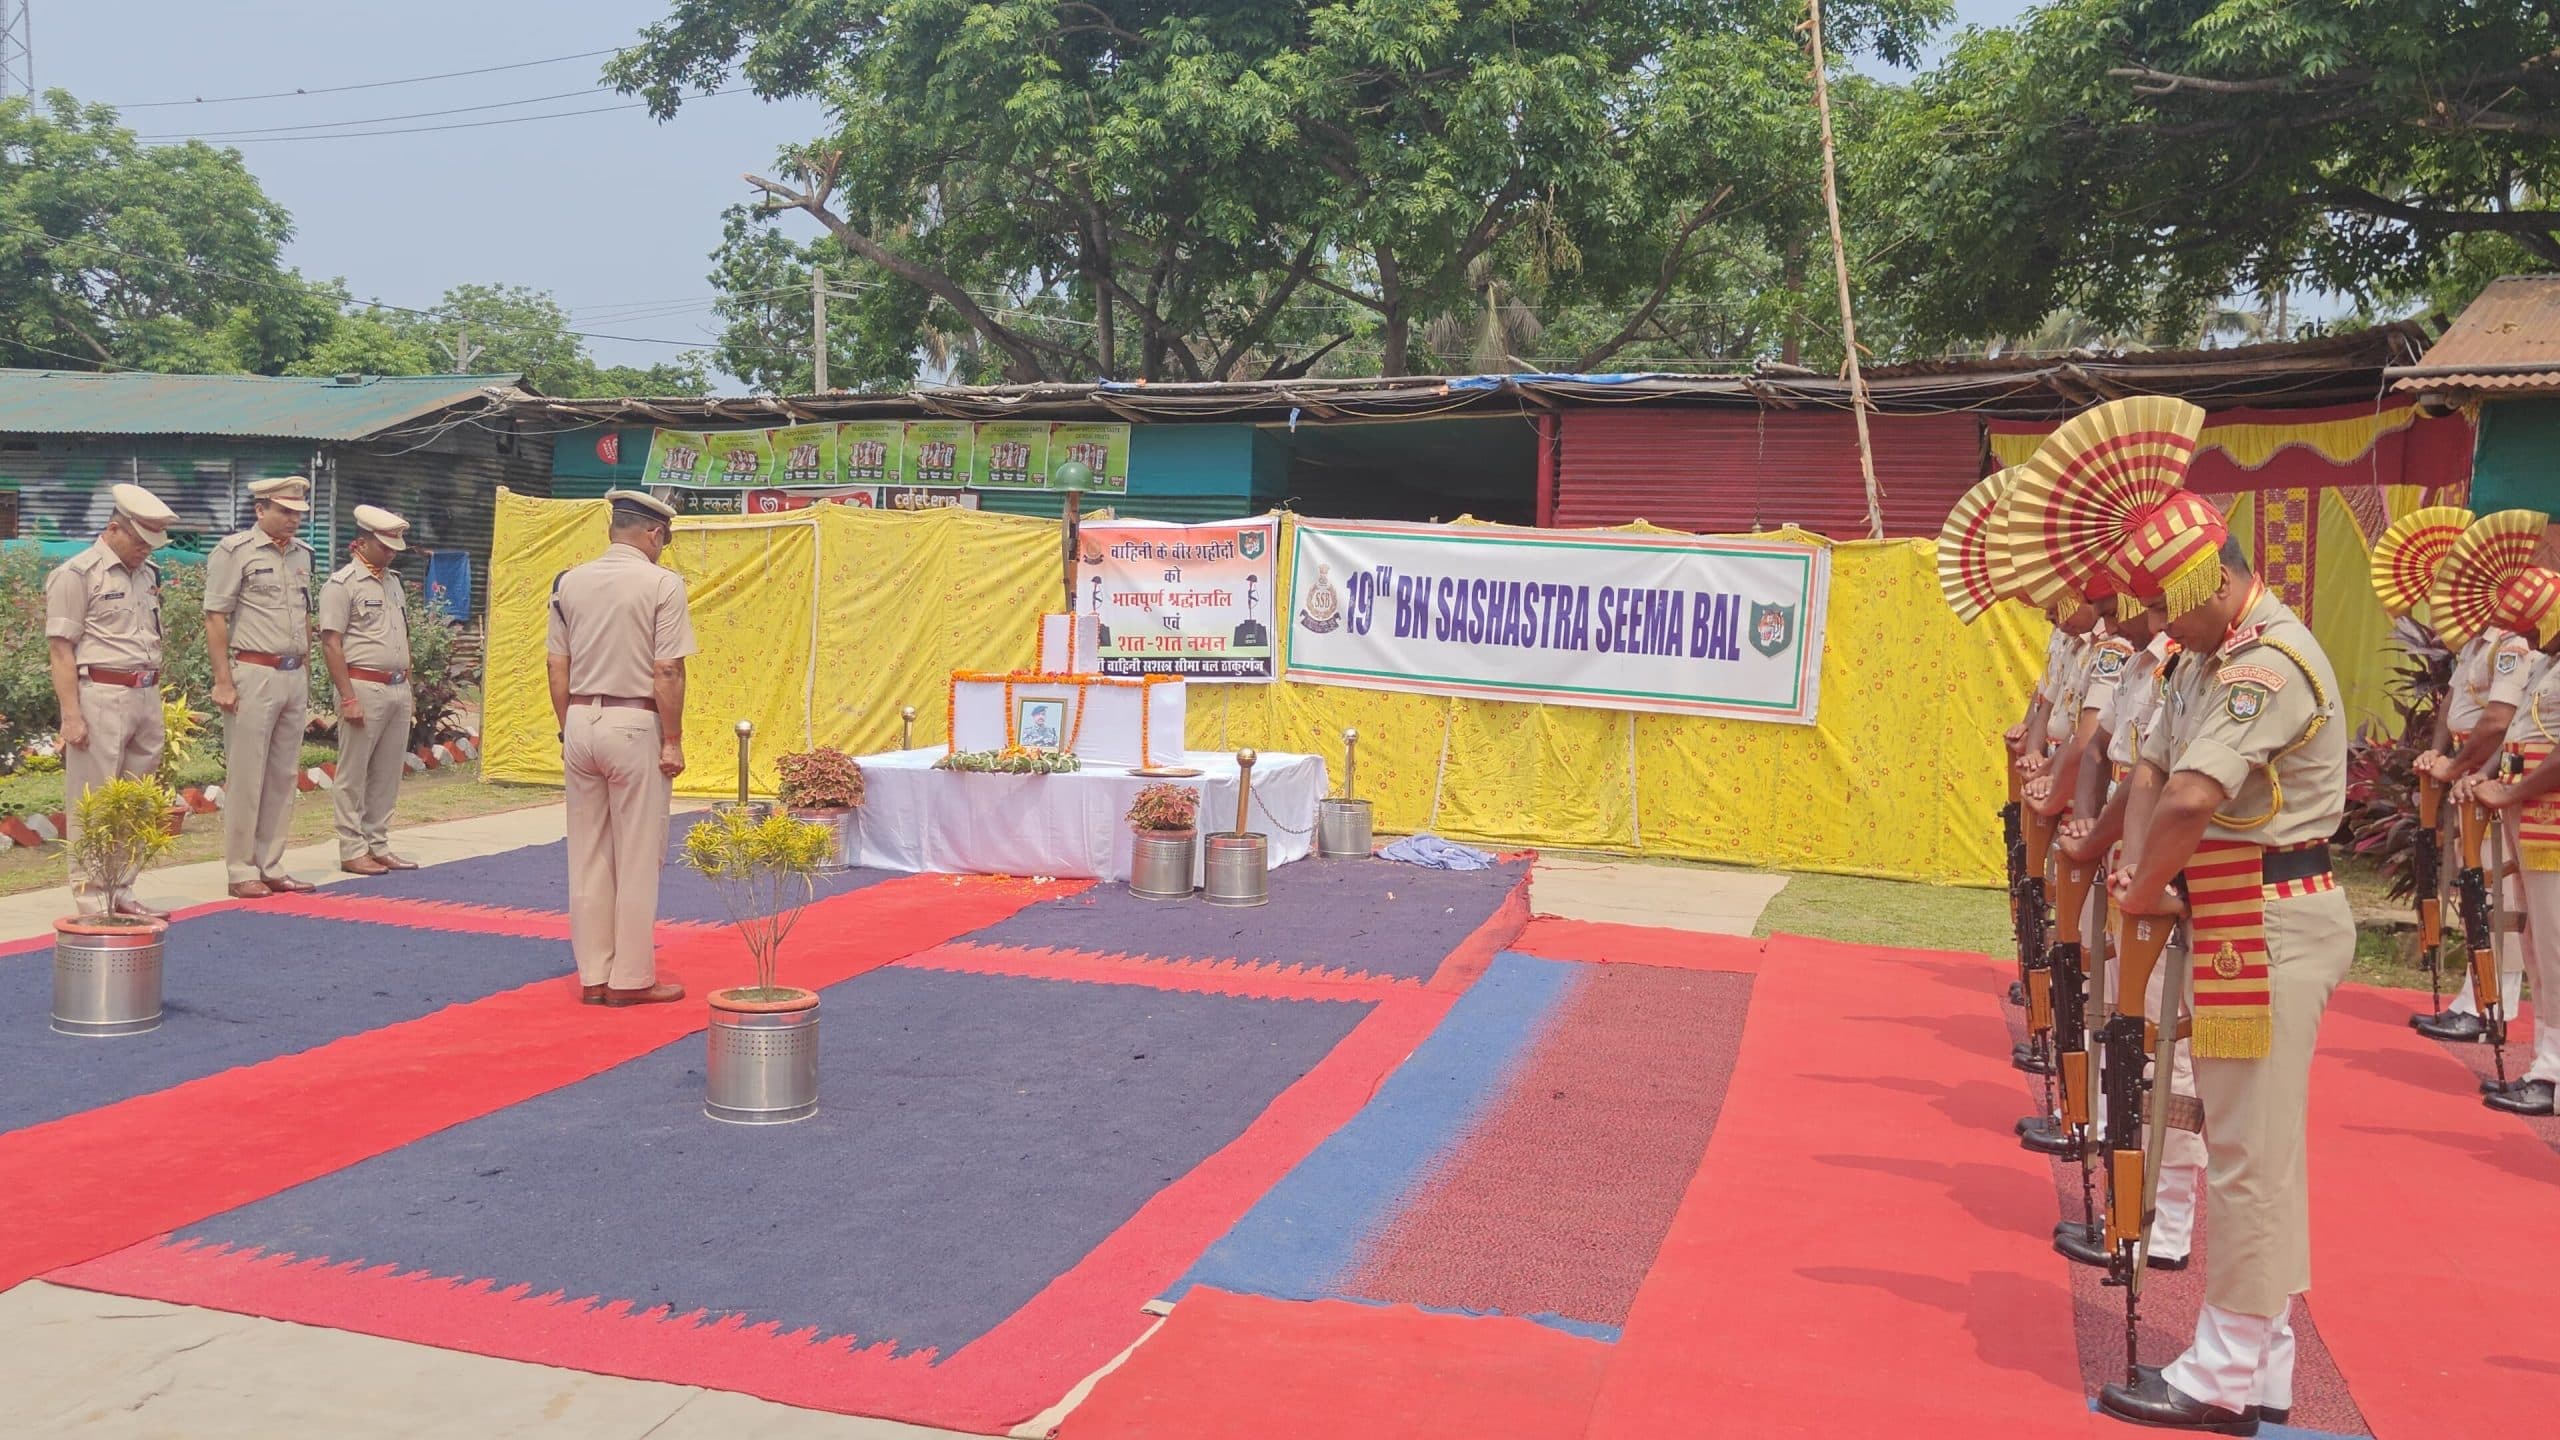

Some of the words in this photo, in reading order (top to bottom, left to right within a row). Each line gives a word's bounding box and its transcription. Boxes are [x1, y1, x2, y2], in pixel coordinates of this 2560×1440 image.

[894, 488, 957, 511] cafeteria
[1111, 541, 1152, 562] वाहिनी
[1156, 541, 1168, 560] के
[1172, 542, 1191, 560] वीर
[1196, 540, 1234, 561] शहीदों
[1164, 566, 1181, 583] को
[1113, 589, 1165, 612] भावपूर्ण
[1168, 589, 1232, 608] श्रद्धांजलि
[1314, 592, 1330, 608] SSB
[1163, 613, 1181, 630] एवं
[1394, 574, 1432, 640] BN
[1435, 577, 1589, 652] SASHASTRA
[1595, 586, 1683, 658] SEEMA
[1690, 591, 1741, 662] BAL
[1187, 636, 1227, 651] नमन
[1107, 658, 1141, 674] वाहिनी
[1142, 659, 1172, 673] सशस्त्र
[1174, 658, 1199, 672] सीमा
[1202, 660, 1217, 672] बल
[1221, 657, 1264, 675] ठाकुरगंज
